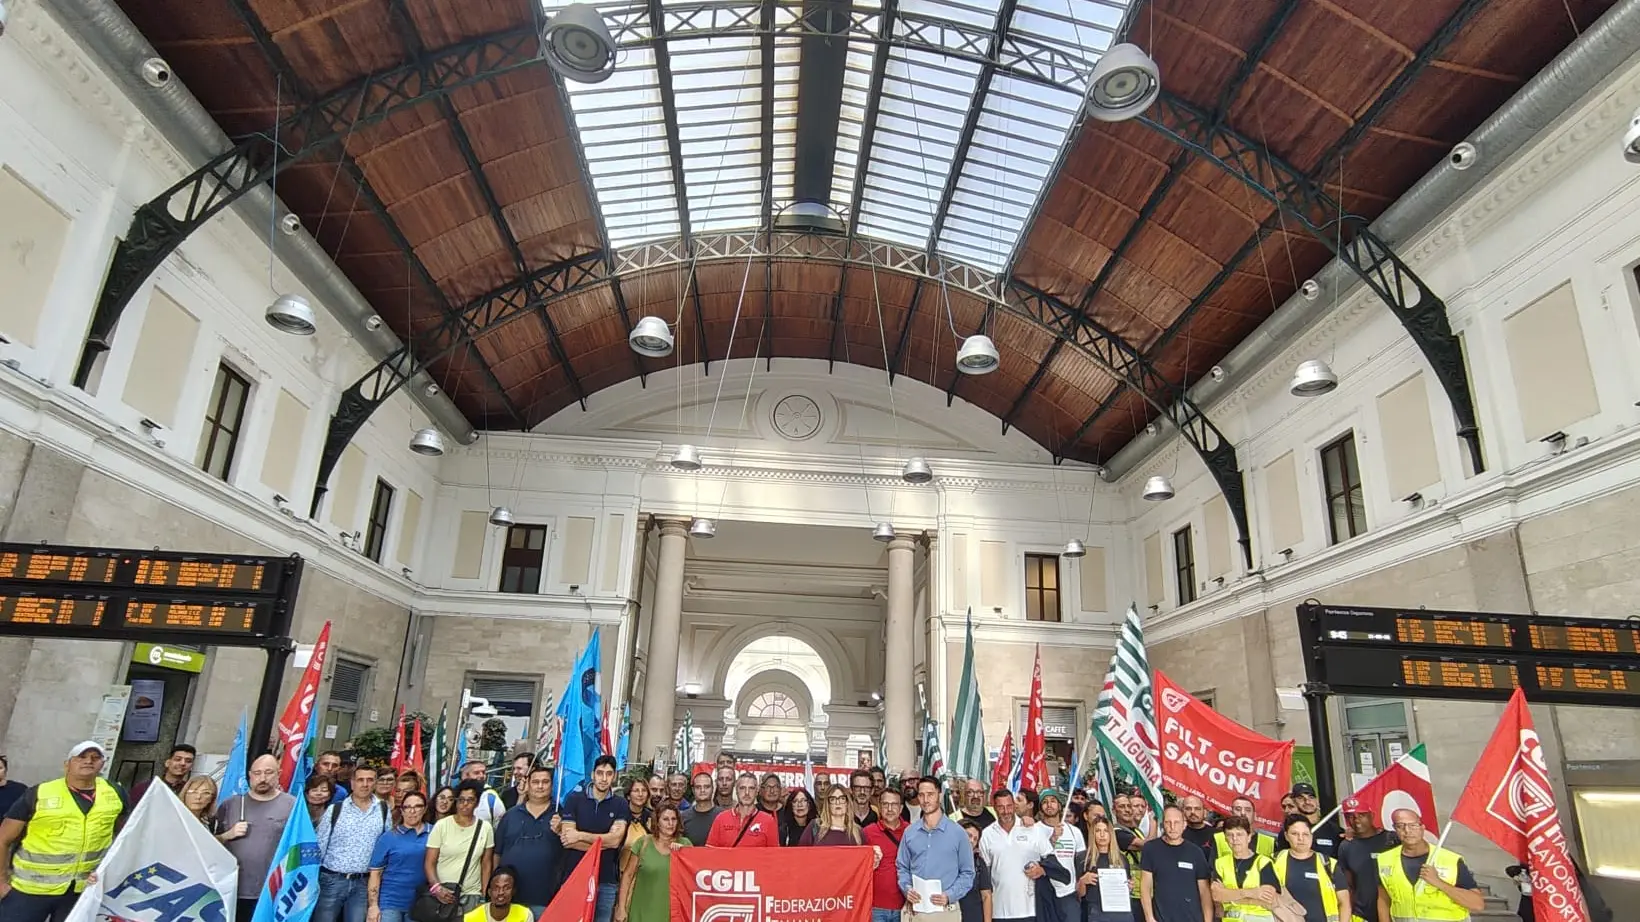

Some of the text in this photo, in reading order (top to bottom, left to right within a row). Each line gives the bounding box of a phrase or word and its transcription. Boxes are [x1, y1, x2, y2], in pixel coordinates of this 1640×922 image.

[1116, 729, 1161, 789] LIGURIA
[1163, 741, 1262, 800] SAVONA
[1164, 716, 1277, 781] FILT CGIL
[694, 869, 761, 893] CGIL
[765, 894, 854, 914] FEDERAZIONE
